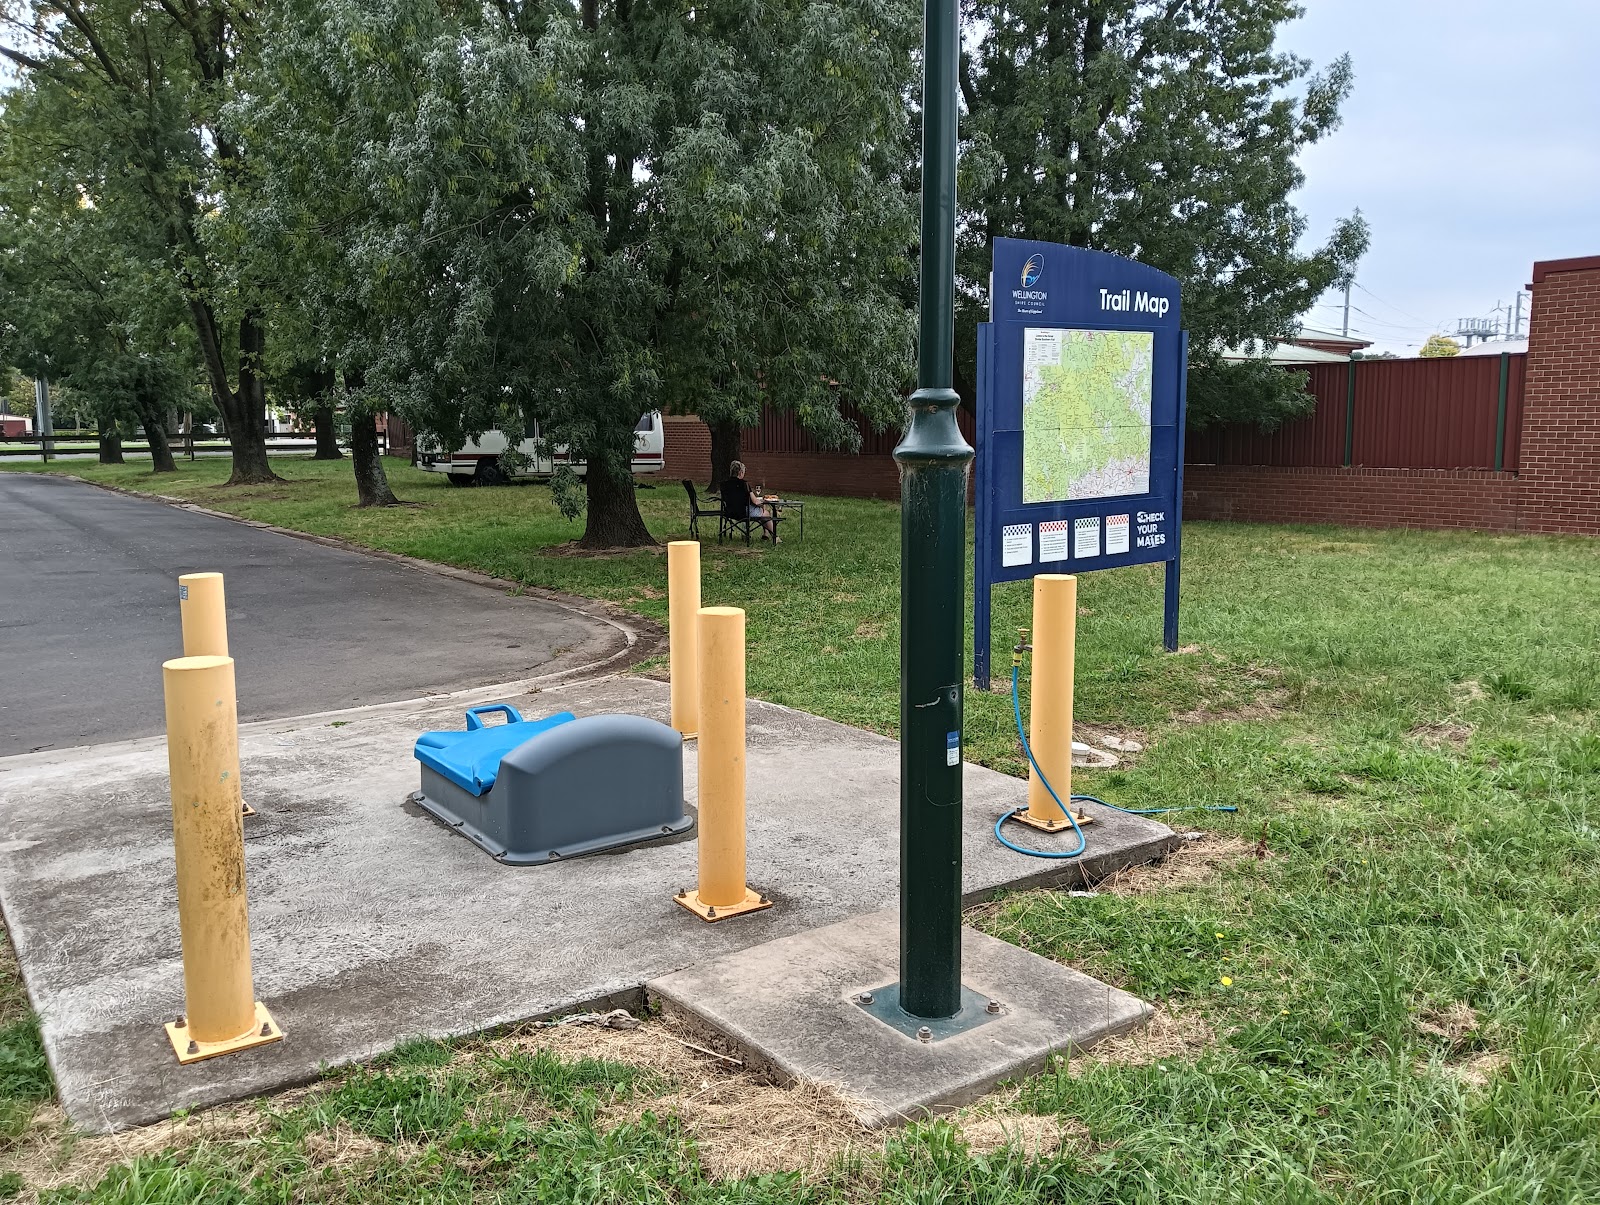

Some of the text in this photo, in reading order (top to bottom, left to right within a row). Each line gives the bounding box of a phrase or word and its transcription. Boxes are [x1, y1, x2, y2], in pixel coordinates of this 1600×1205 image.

[1012, 290, 1048, 300] WELLINGTON
[1099, 288, 1170, 319] Trail Map
[1136, 511, 1165, 523] CHECK
[1136, 523, 1158, 535] YOUR
[1136, 533, 1166, 548] MATES
